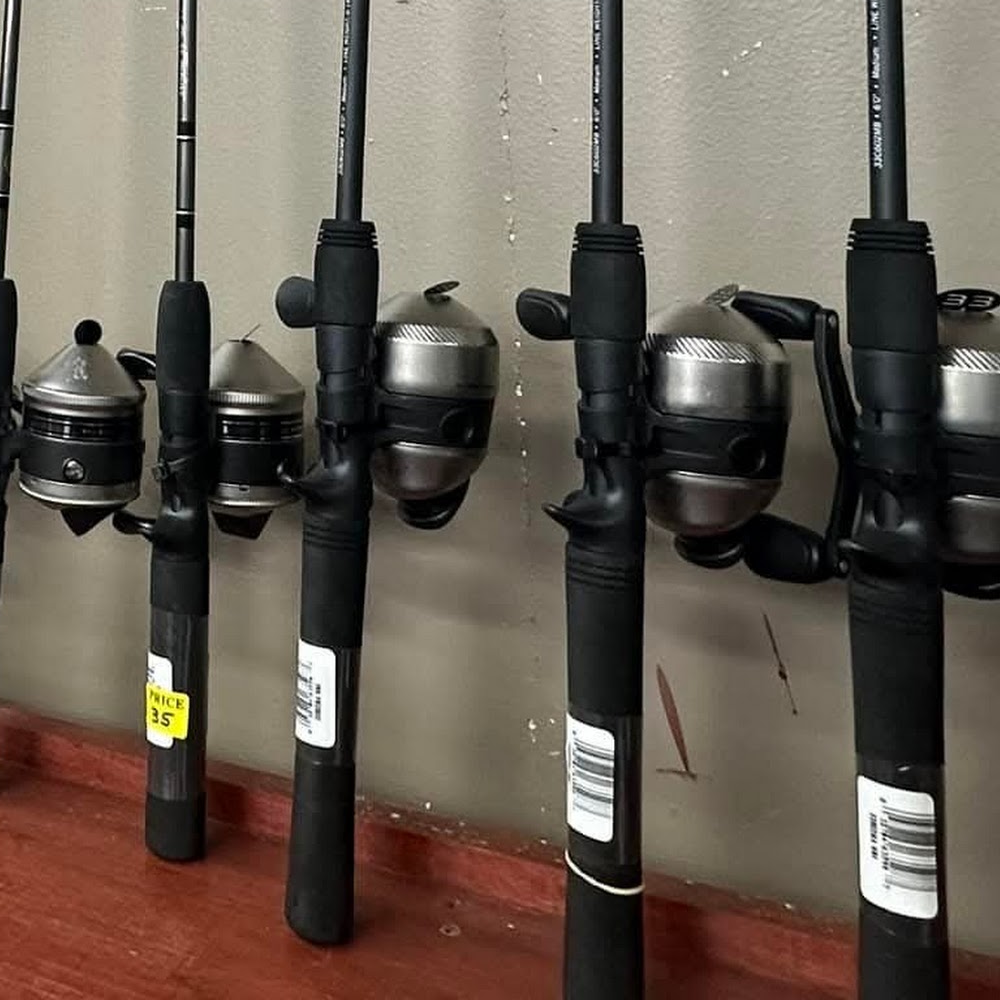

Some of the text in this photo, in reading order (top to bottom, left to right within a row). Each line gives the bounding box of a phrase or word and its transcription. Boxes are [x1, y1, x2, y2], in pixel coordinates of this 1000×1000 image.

[941, 293, 994, 308] 33
[148, 688, 186, 711] PRICE
[151, 706, 176, 728] 35
